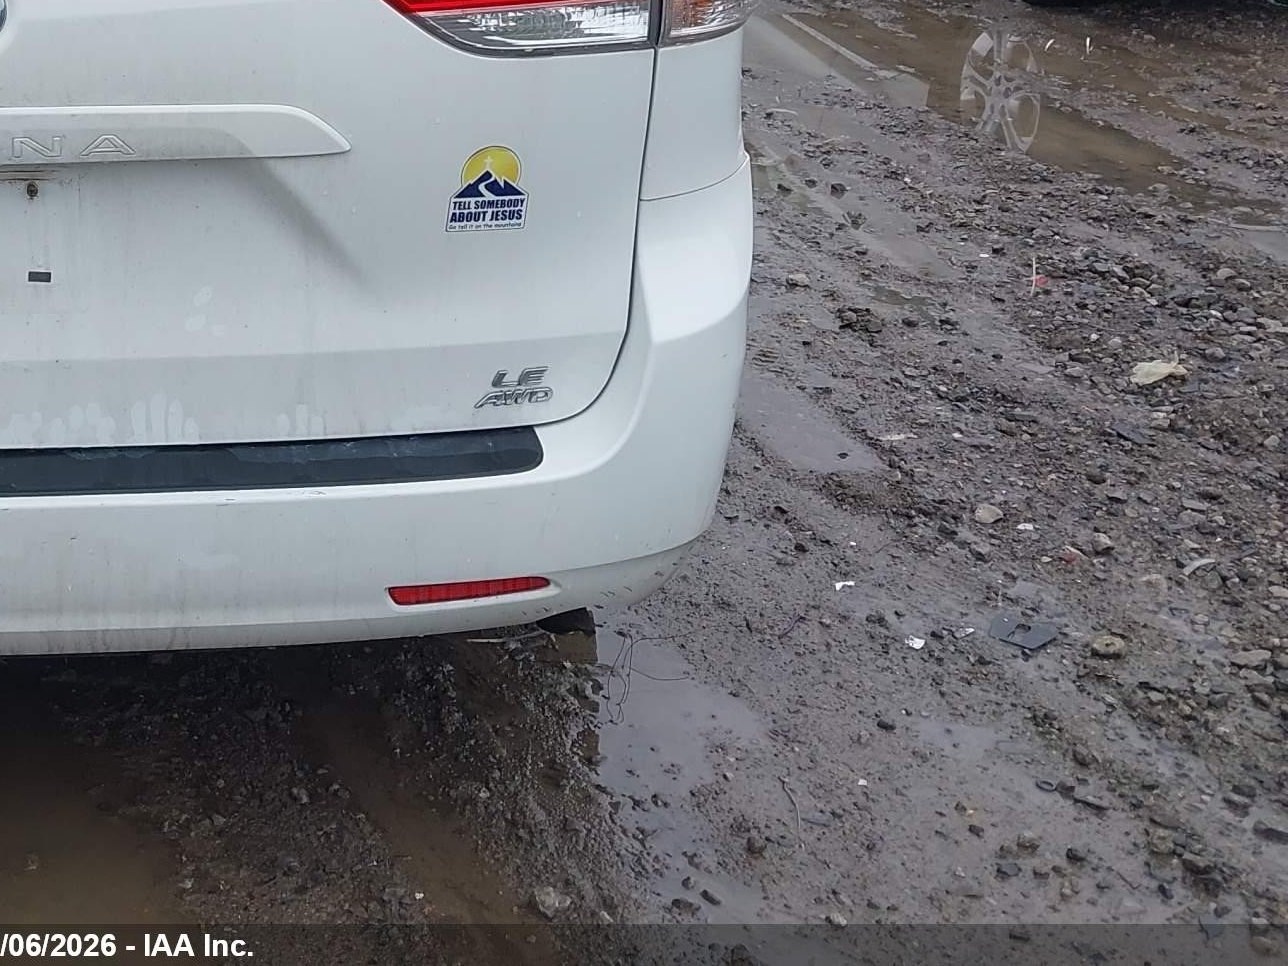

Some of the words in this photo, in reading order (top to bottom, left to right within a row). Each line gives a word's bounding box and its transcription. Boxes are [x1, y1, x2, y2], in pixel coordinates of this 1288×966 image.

[452, 200, 472, 211] TELL
[474, 198, 525, 210] SOMEBODY
[449, 211, 488, 223] ABOUT
[489, 209, 523, 221] JESUS
[491, 366, 549, 388] LE
[473, 386, 554, 409] AWD
